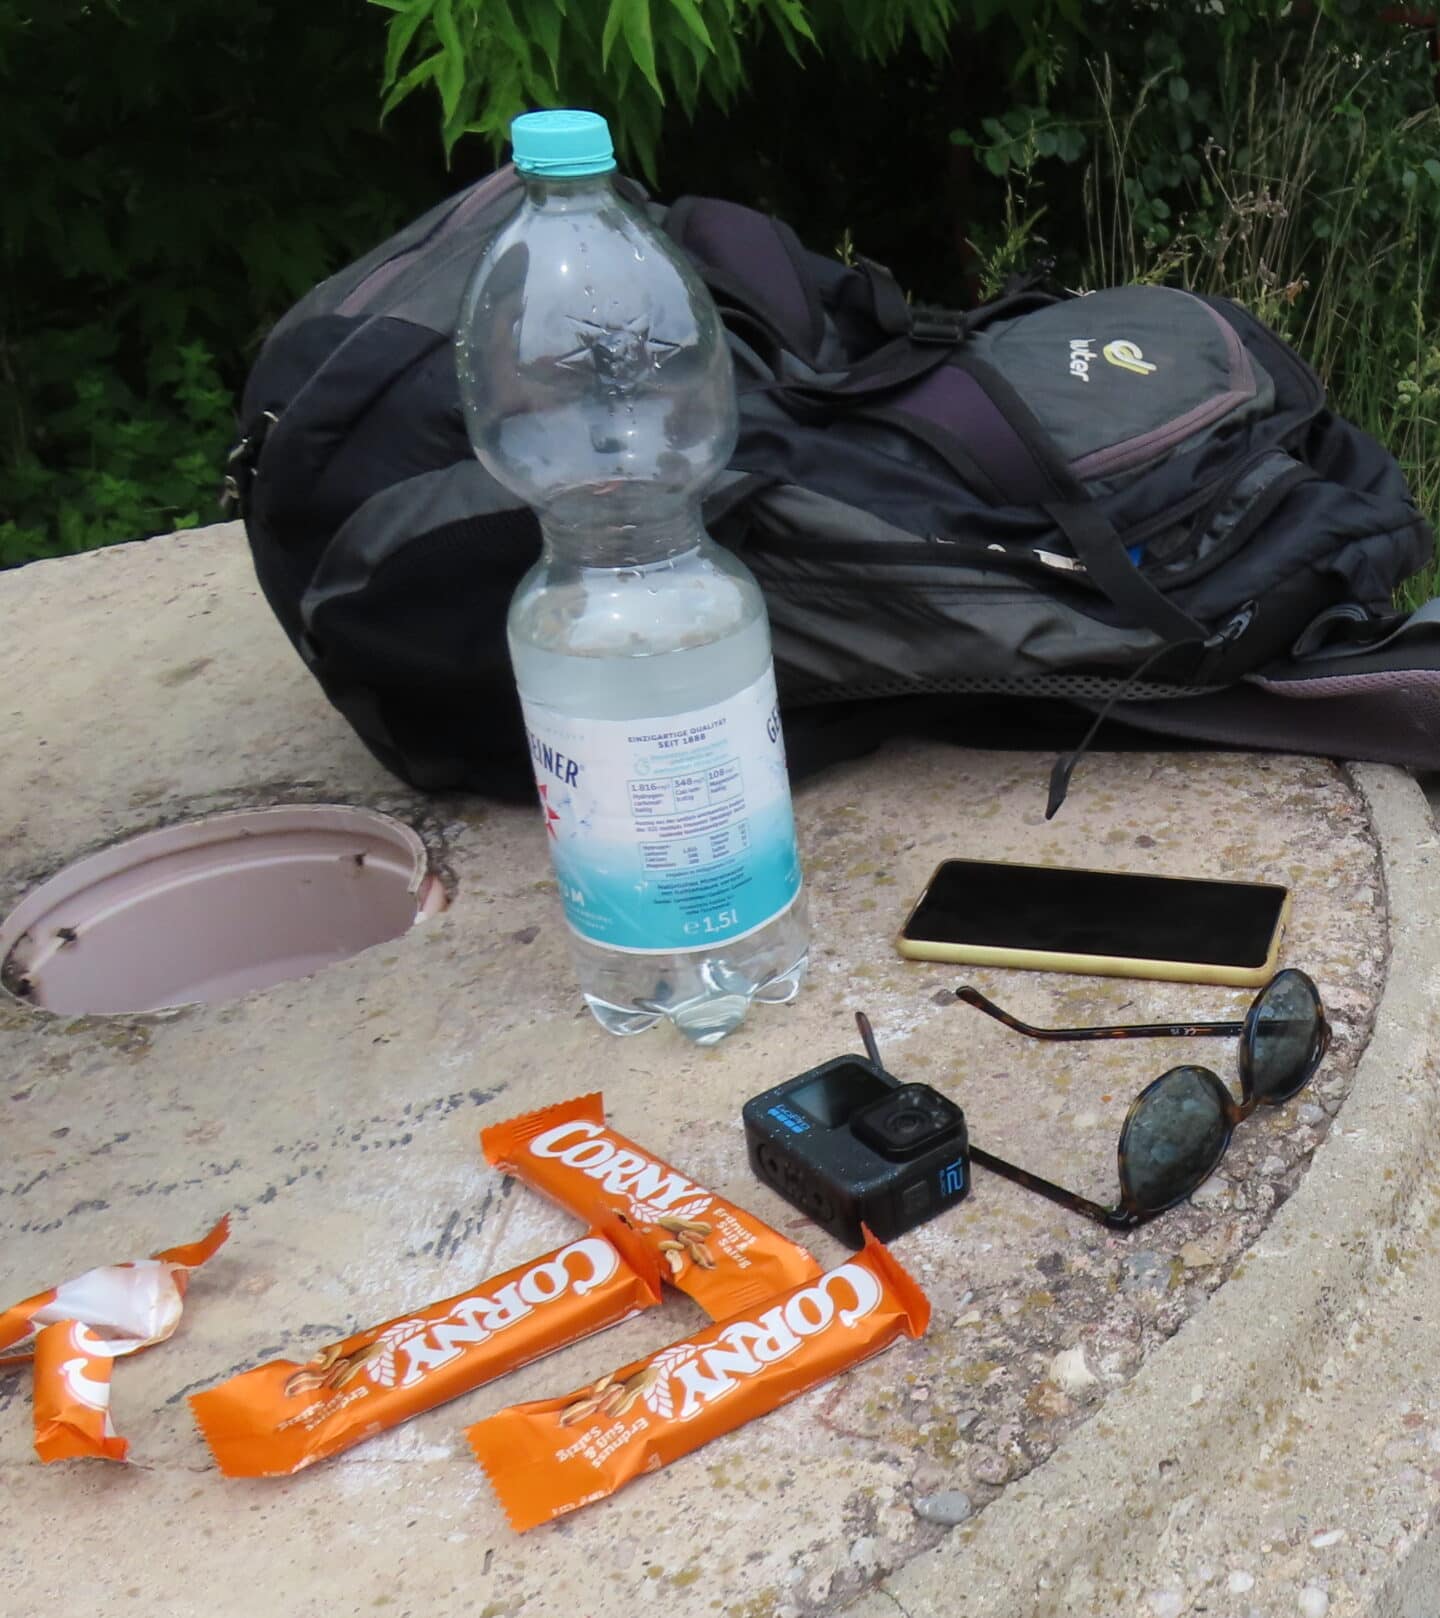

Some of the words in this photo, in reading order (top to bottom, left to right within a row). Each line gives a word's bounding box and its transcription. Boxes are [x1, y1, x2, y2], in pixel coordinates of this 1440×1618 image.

[1069, 338, 1098, 383] uter
[628, 730, 687, 743] EINZIGARTIGE
[766, 702, 782, 744] GE
[527, 730, 579, 788] EINER
[658, 739, 679, 749] SEIT
[703, 908, 738, 933] 1,5l
[529, 1120, 710, 1210] CORNY
[945, 1156, 964, 1194] 12
[713, 1207, 757, 1245] Erdnuss
[717, 1238, 753, 1270] Salzig
[399, 1237, 620, 1388] CORNY
[672, 1263, 882, 1420] CORNY
[555, 1425, 603, 1463] Salzig
[592, 1416, 650, 1469] Erdnuss
